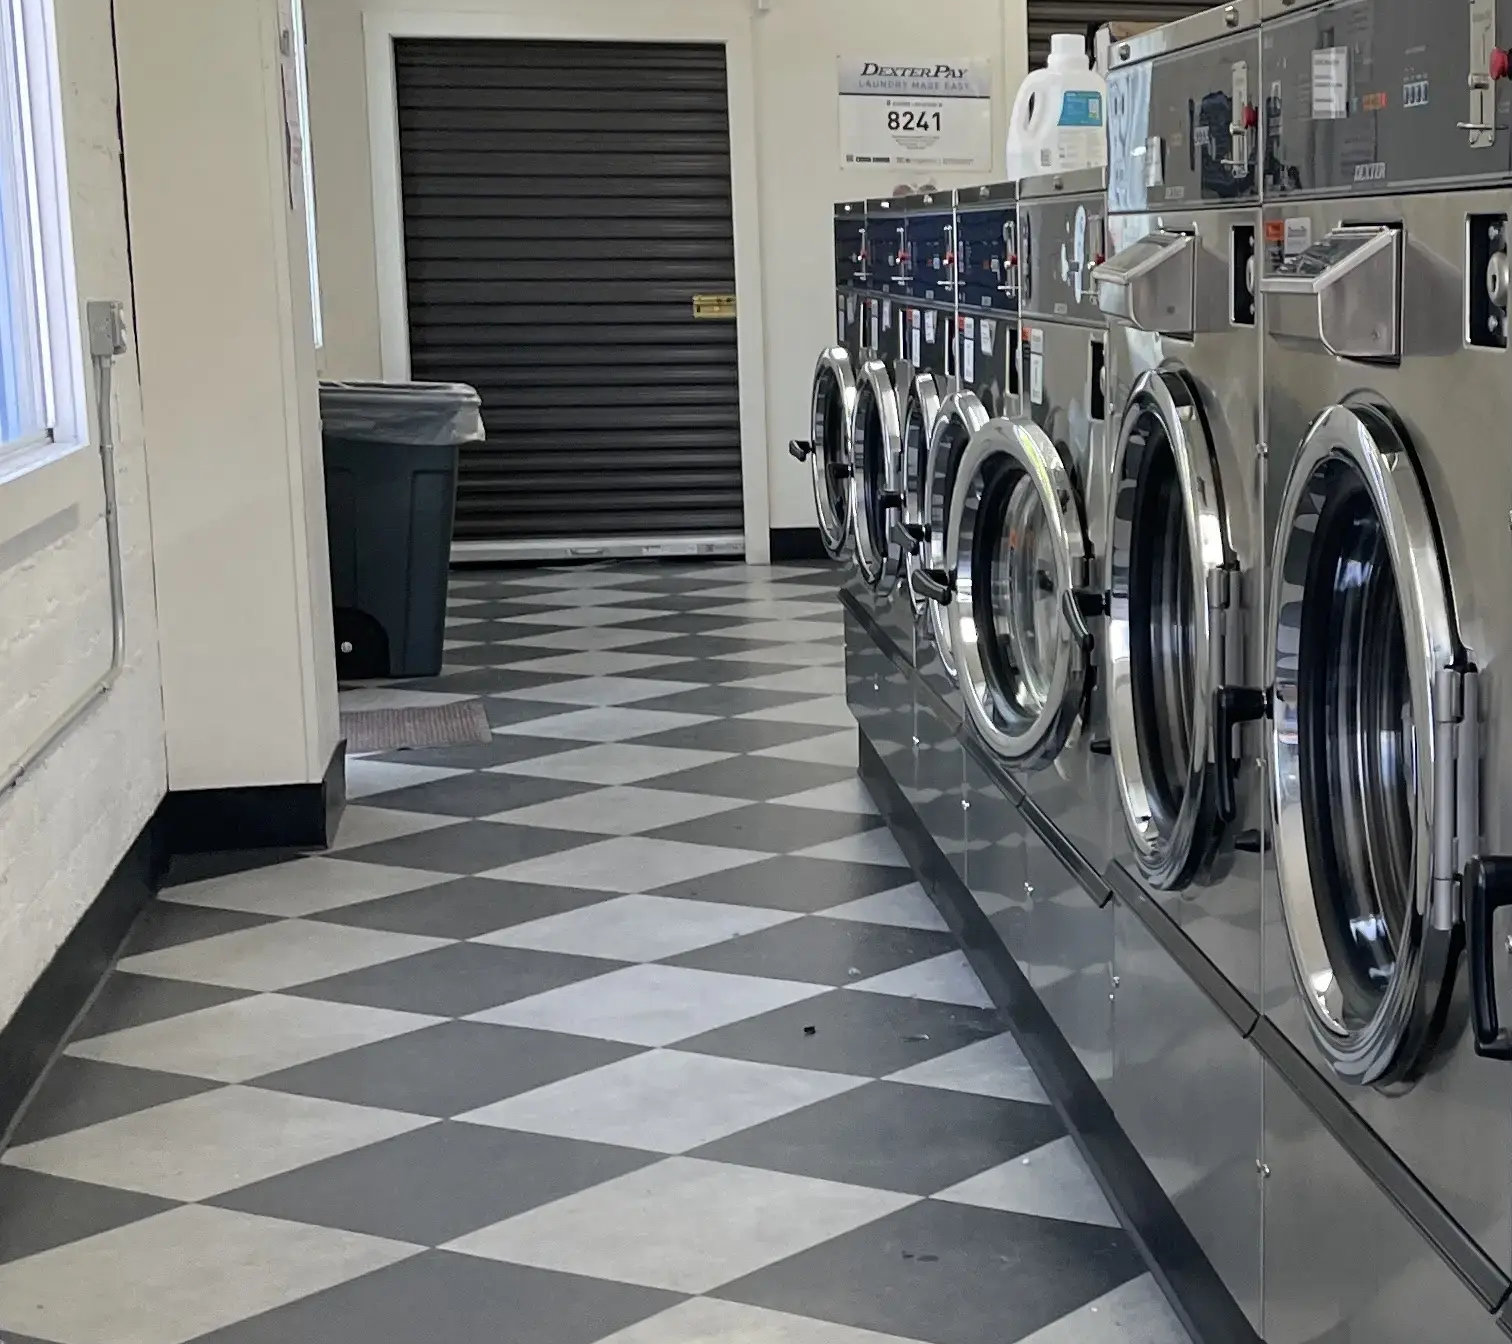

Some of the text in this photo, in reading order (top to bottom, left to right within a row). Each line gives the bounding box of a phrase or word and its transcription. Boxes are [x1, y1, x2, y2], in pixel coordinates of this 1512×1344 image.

[858, 80, 970, 91] LAUNDRY MADE EASY
[887, 111, 941, 132] 8241
